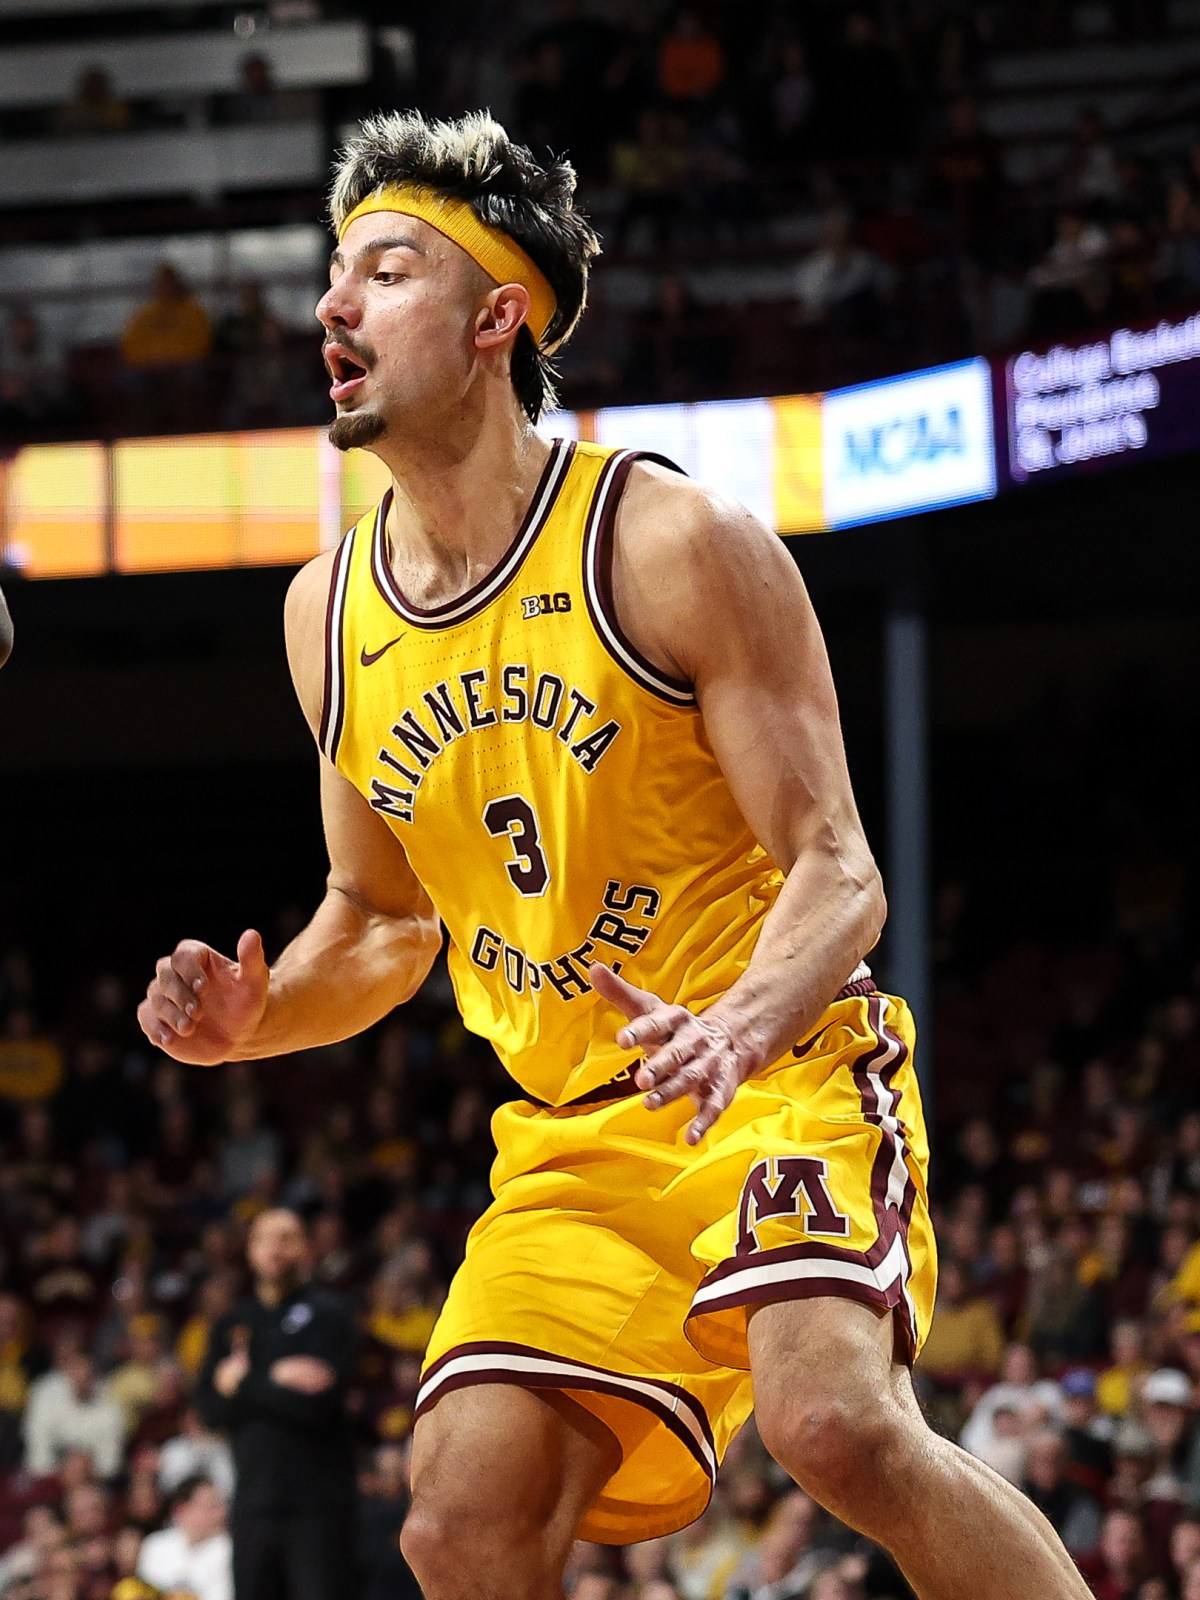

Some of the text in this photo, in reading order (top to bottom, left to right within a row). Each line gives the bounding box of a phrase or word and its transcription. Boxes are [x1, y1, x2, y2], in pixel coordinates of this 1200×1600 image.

[369, 664, 621, 824] MINNESOTA
[481, 793, 551, 897] 3
[733, 1155, 850, 1257] M
